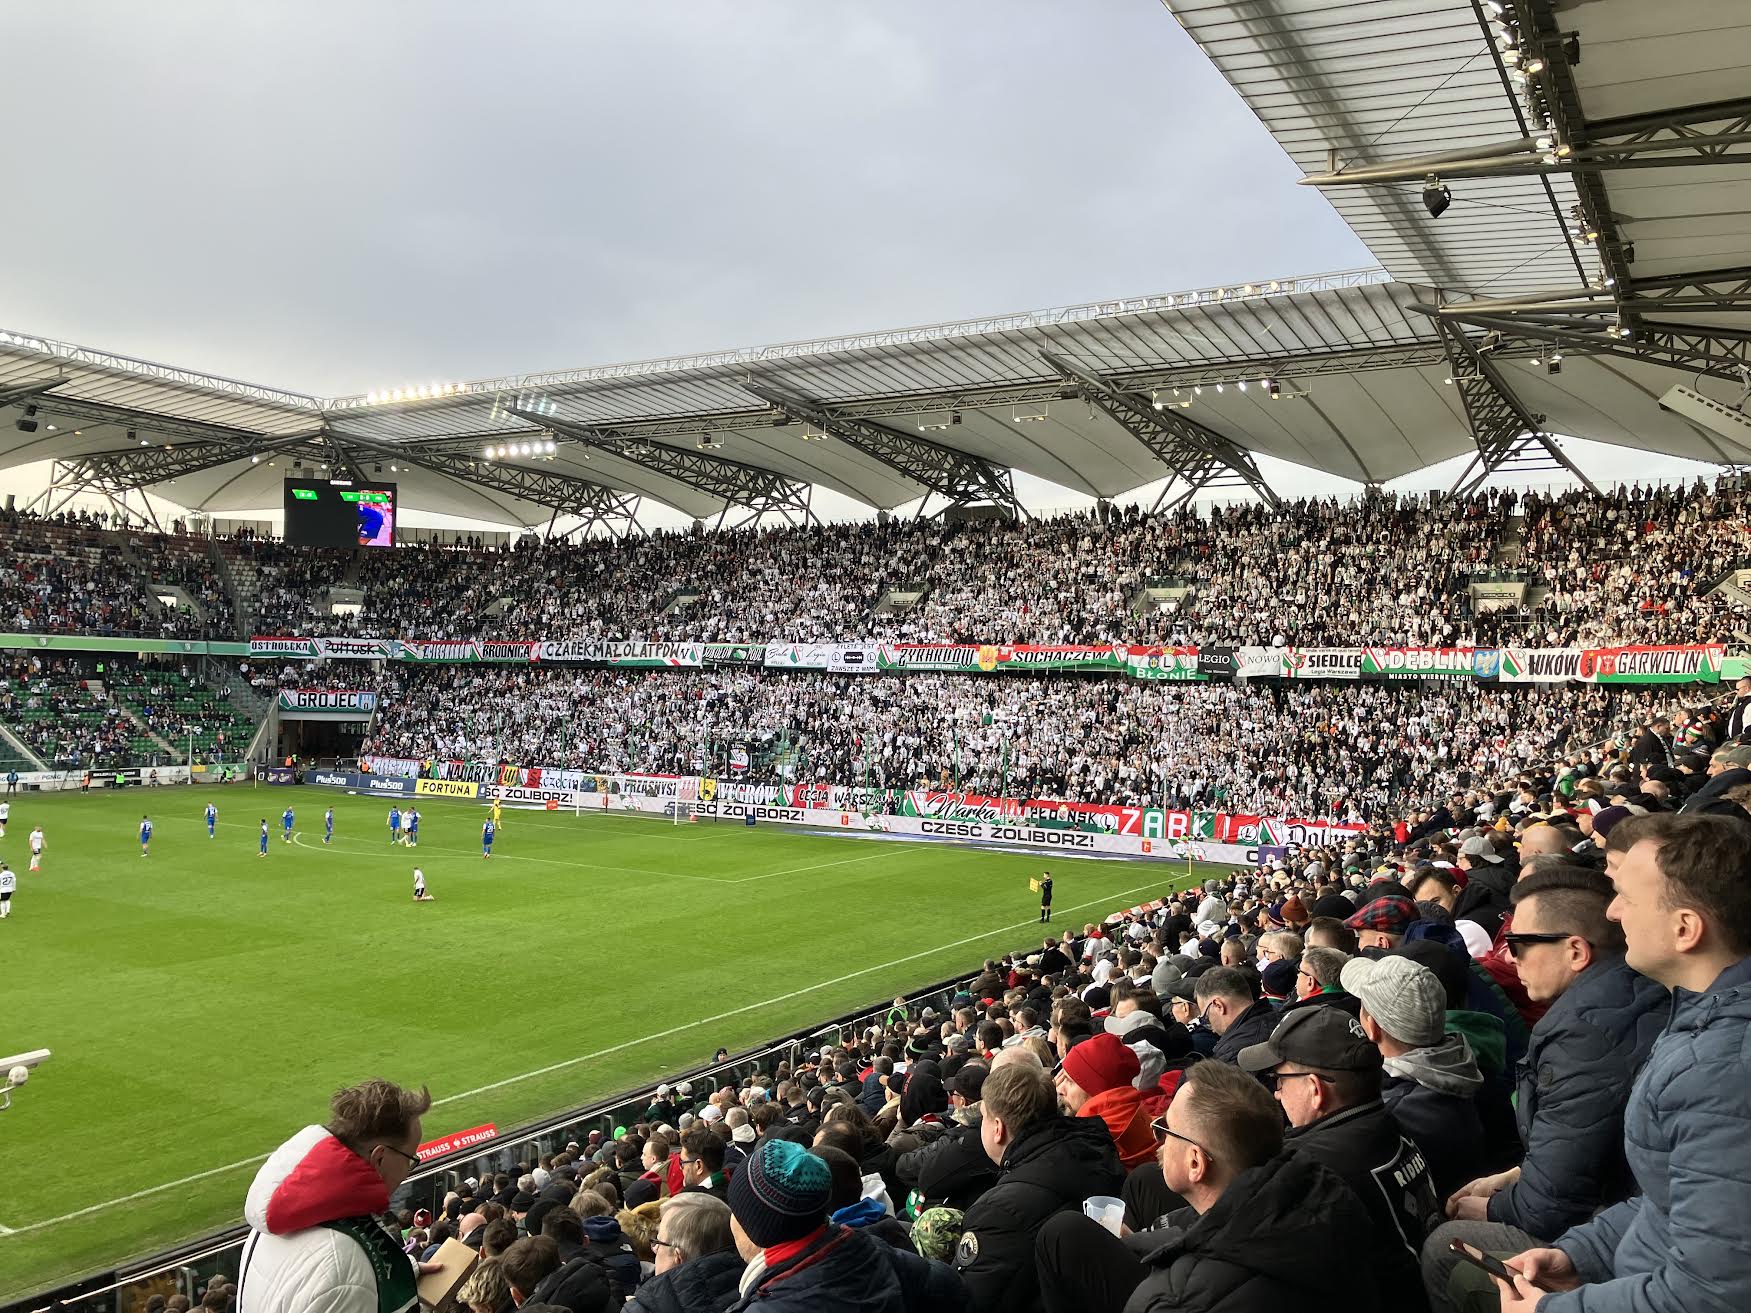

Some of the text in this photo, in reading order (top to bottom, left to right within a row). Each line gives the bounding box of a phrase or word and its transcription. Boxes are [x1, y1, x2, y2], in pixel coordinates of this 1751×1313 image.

[482, 644, 530, 658] BRODNICA
[546, 642, 593, 657] CZAREK
[1013, 651, 1107, 663] SOCHACZEW
[1388, 651, 1473, 670] DĘBLIN
[1528, 652, 1581, 676] ŁUKÓW
[1617, 651, 1700, 675] GARWOLIN
[1136, 668, 1197, 680] BŁONIE
[316, 774, 347, 786] Plus500
[370, 779, 404, 791] Plus500
[422, 782, 471, 796] FORTUNA
[799, 789, 829, 803] LEGIA
[926, 794, 998, 822] Warka
[990, 824, 1095, 848] ŻOLIBORZ!
[2, 876, 13, 886] 27
[416, 1129, 495, 1159] STRAUSS STRAUSS
